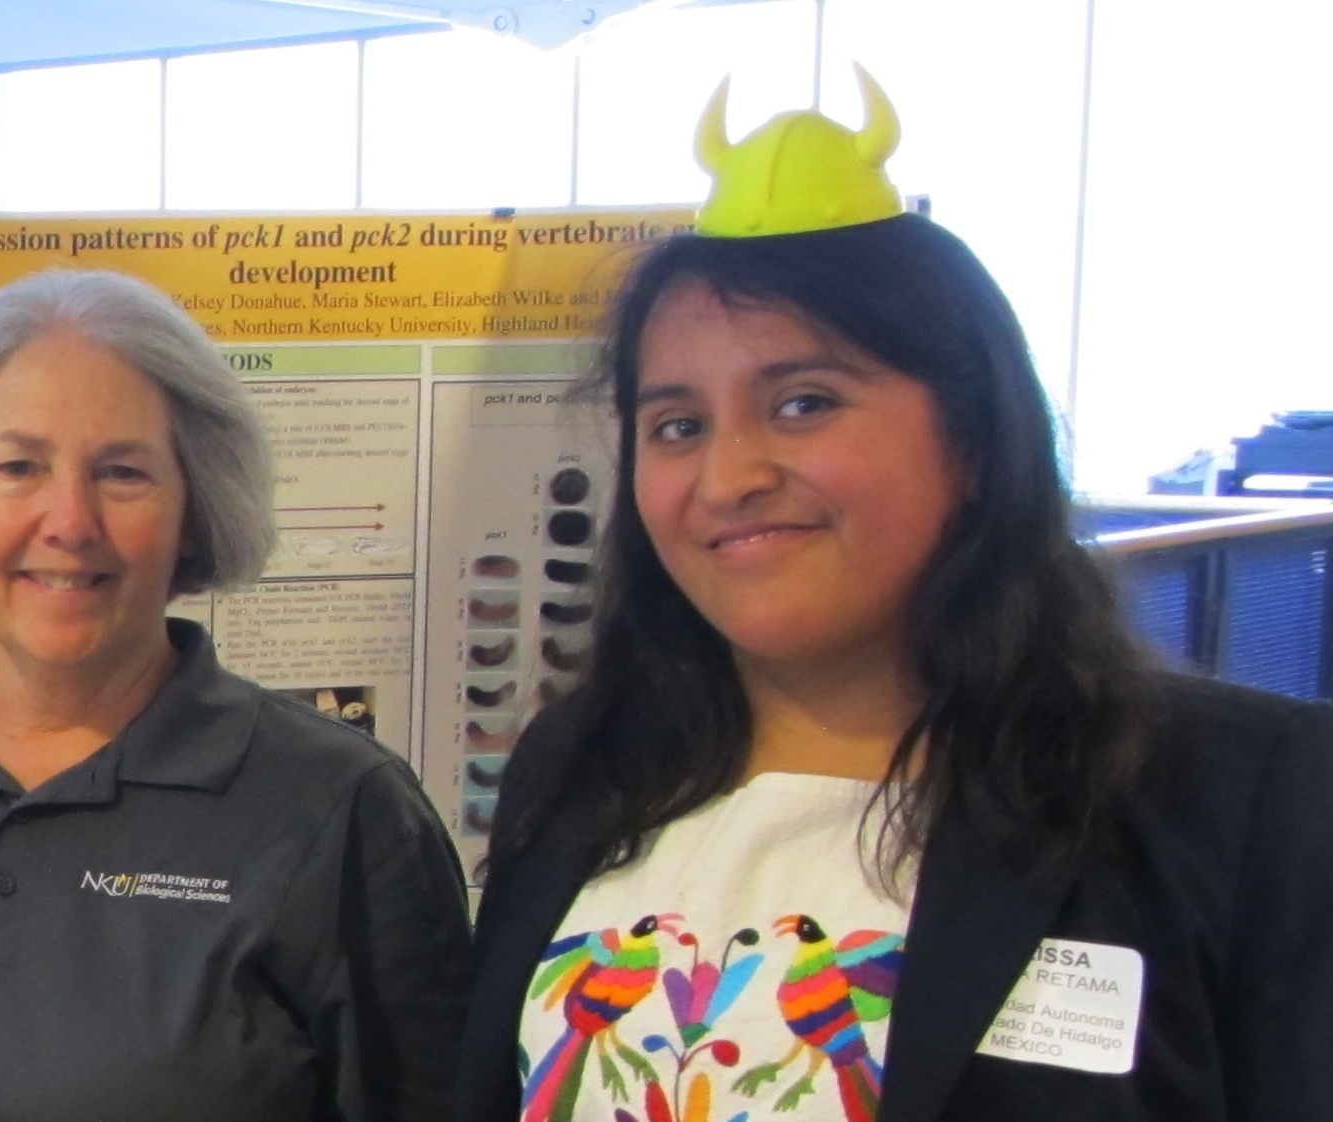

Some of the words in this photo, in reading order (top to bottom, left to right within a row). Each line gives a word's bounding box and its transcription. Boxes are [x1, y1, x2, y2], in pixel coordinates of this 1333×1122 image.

[71, 228, 183, 257] patterns
[192, 225, 222, 249] of
[223, 223, 285, 256] pck1
[295, 223, 343, 249] and
[349, 222, 412, 255] pck2
[419, 222, 508, 252] during
[229, 259, 395, 290] development
[230, 293, 306, 310] Donahue,
[362, 291, 427, 309] Stewart,
[432, 291, 507, 308] Elizabeth
[511, 289, 564, 307] Wilke
[569, 290, 600, 306] and
[232, 318, 303, 335] Northern
[308, 317, 383, 337] Kentucky
[390, 316, 476, 336] University,
[222, 353, 273, 372] ODS
[139, 874, 210, 888] DEPARTMENT
[212, 879, 228, 889] OF
[185, 889, 231, 903] Sciences
[1032, 944, 1090, 968] ISSA
[1035, 968, 1118, 993] RETAMA
[1040, 1004, 1124, 1030] Autonoma
[990, 1032, 1062, 1056] MEXICO
[1031, 1021, 1054, 1037] De
[1059, 1027, 1122, 1050] Hidalgo
